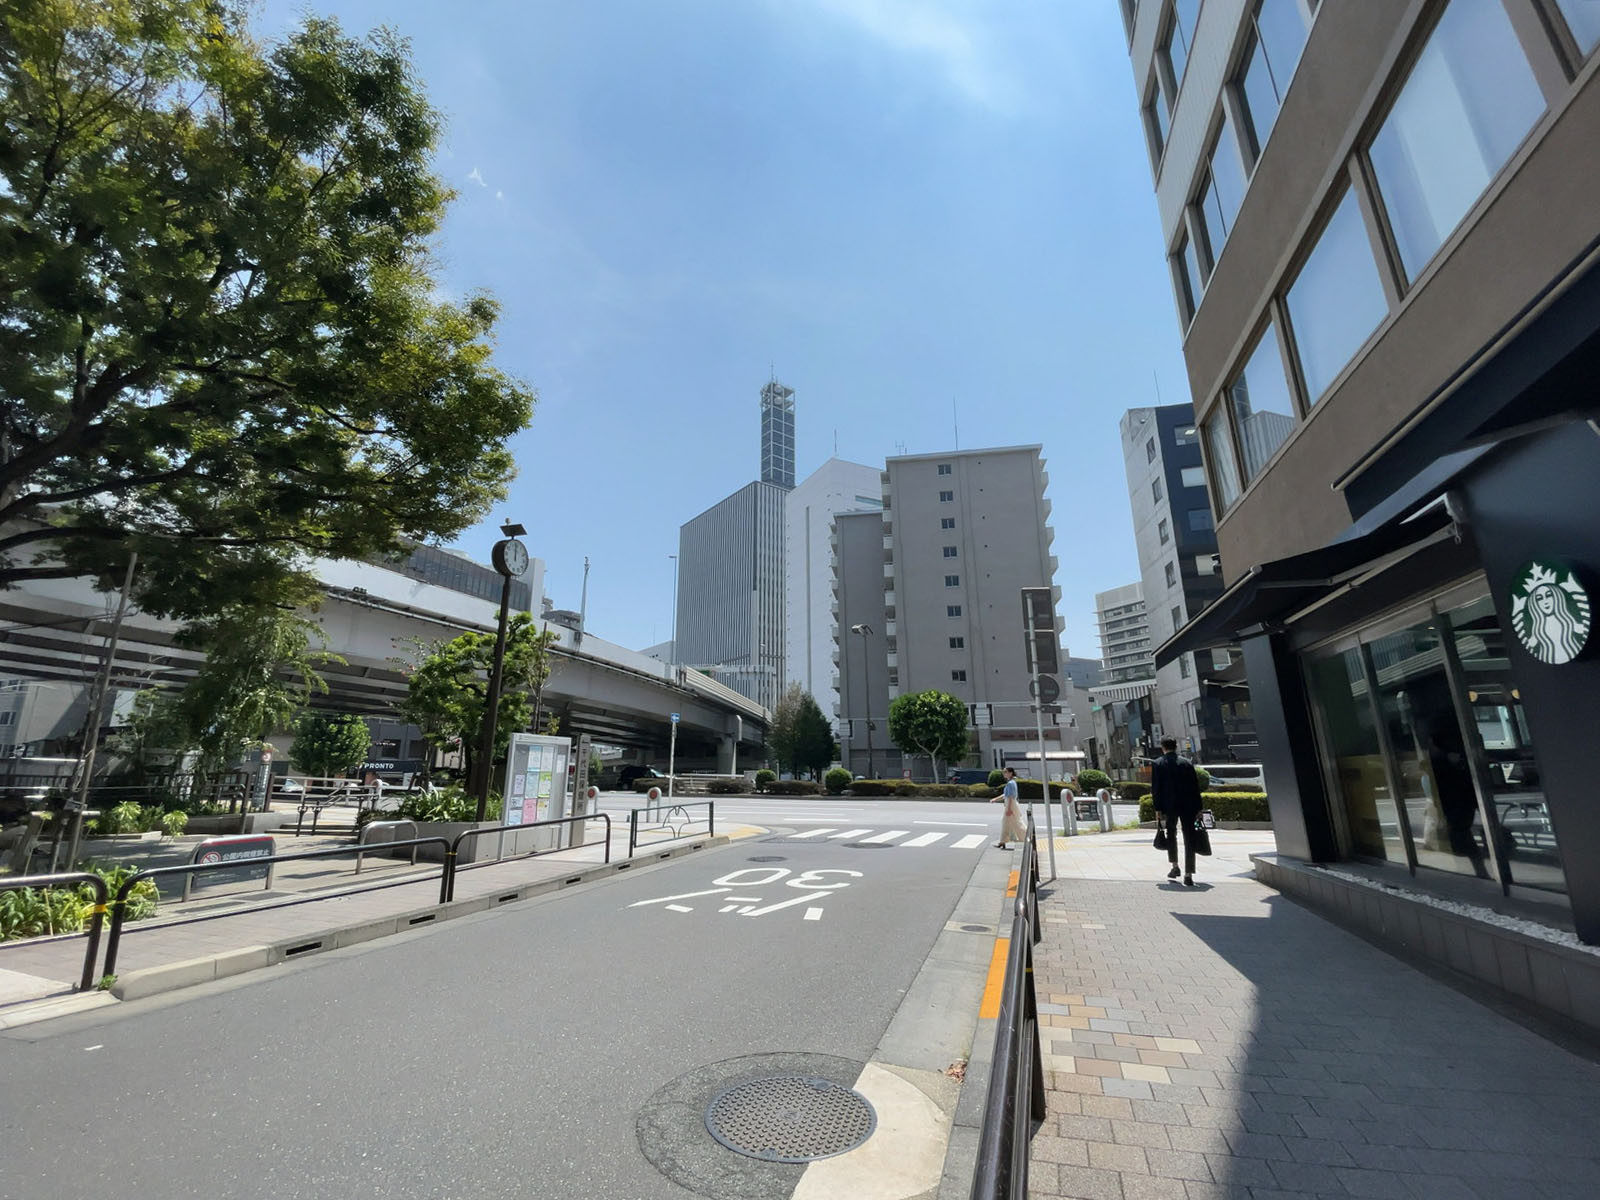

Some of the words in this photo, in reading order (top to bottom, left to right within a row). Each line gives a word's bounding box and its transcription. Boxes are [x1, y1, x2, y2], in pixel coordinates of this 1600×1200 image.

[712, 867, 864, 889] 30
[620, 888, 833, 920] ゾーン
